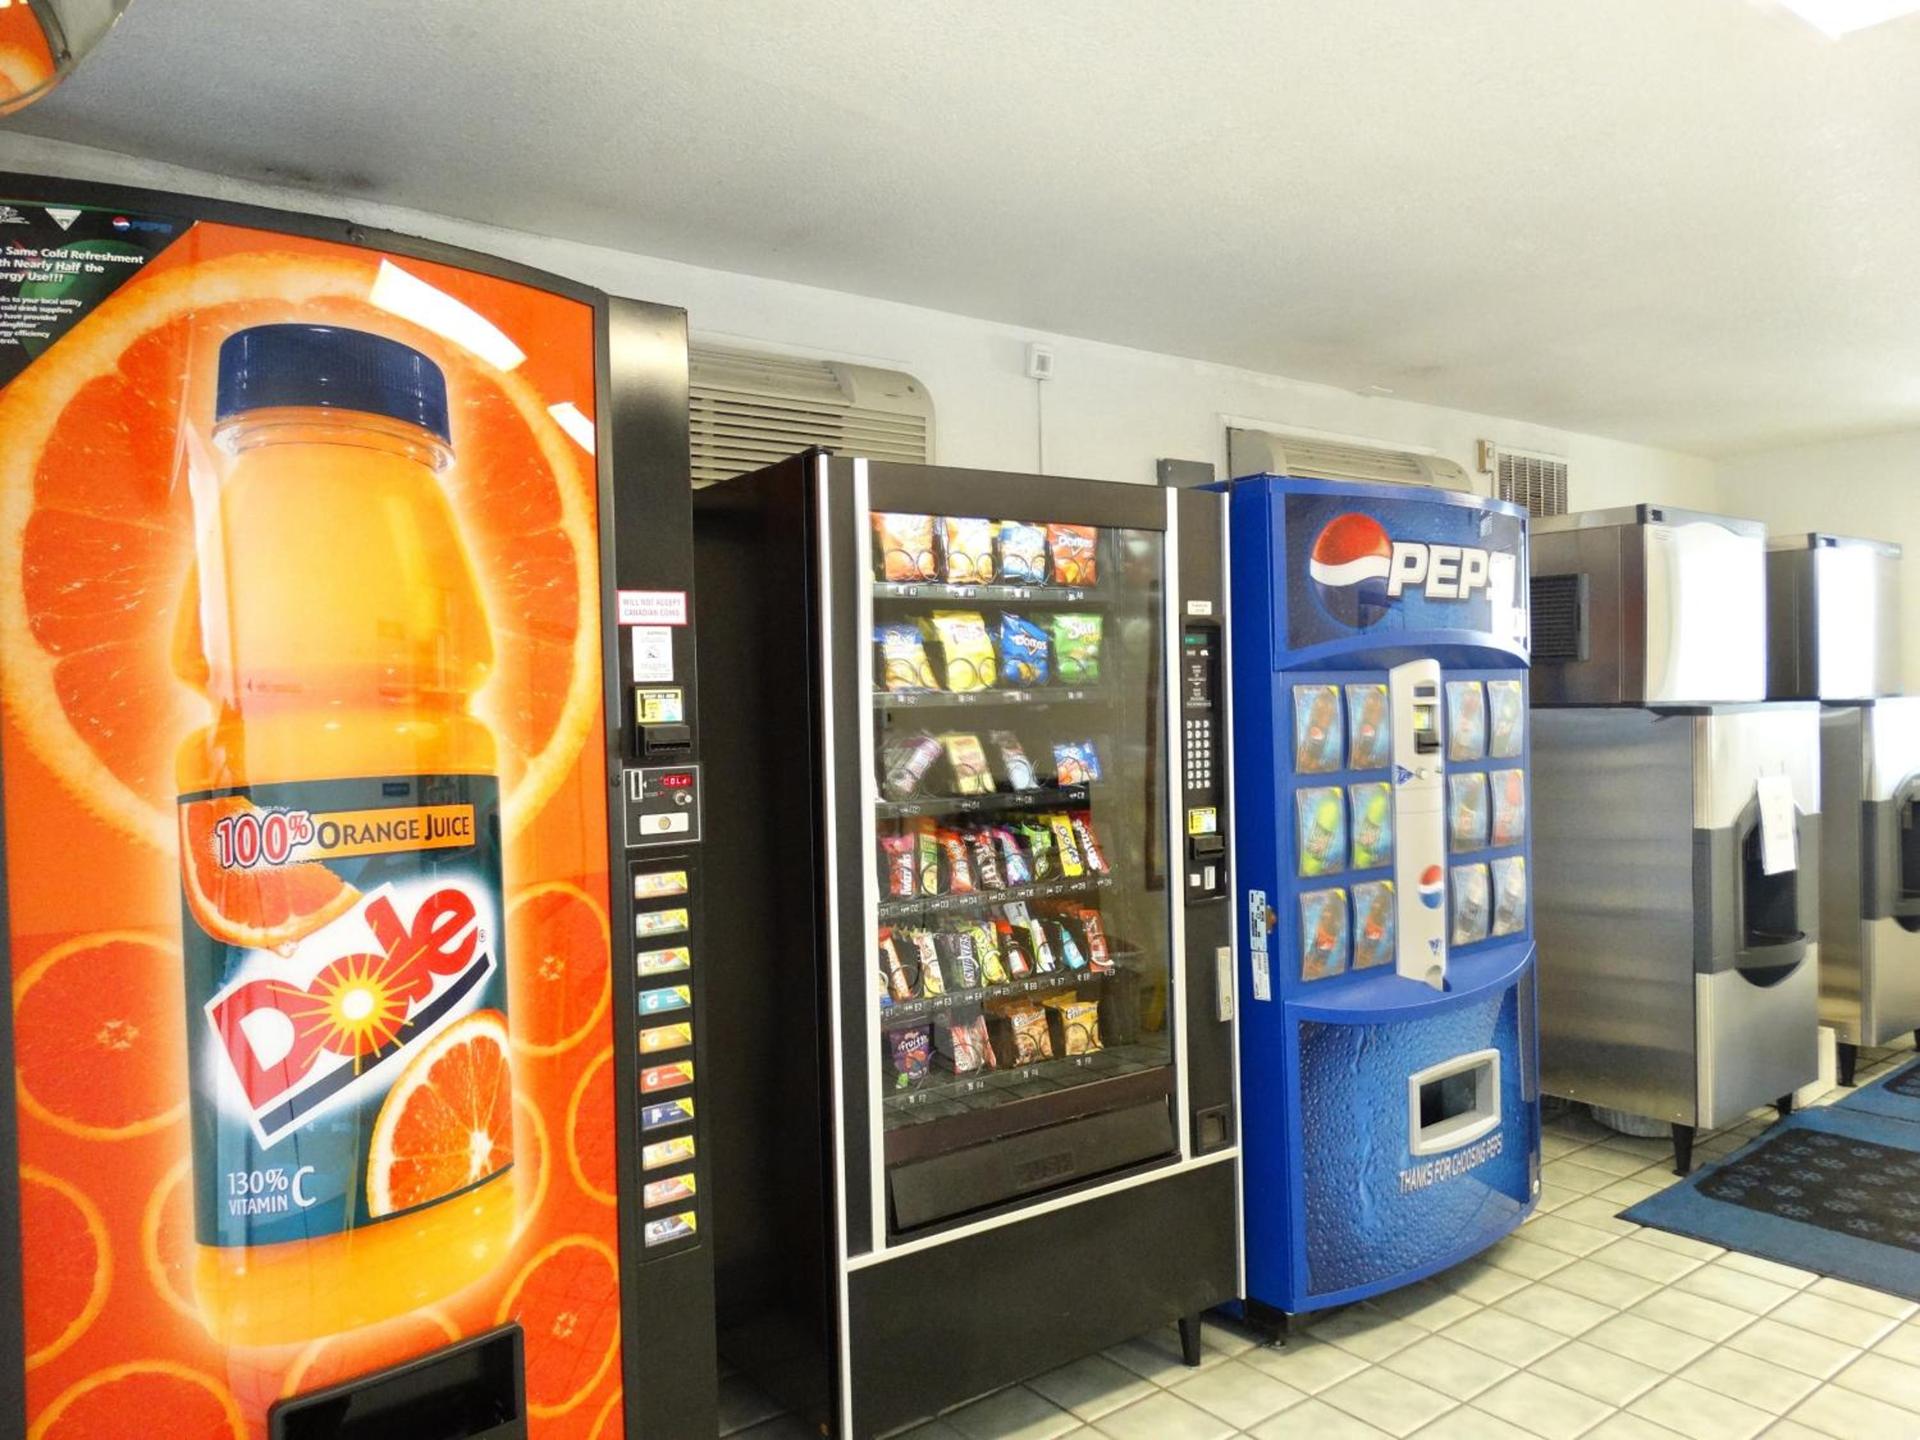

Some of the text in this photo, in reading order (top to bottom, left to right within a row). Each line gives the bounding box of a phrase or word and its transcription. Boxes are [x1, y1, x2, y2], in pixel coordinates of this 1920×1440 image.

[6, 246, 144, 265] Same Cold Refreshment
[13, 259, 53, 272] Nearly
[55, 261, 81, 273] Half
[85, 264, 105, 274] the
[216, 811, 470, 869] 100% ORANGE JUICE
[211, 888, 479, 1111] Dole
[226, 1167, 289, 1196] 130%
[228, 1165, 317, 1217] VITAMIN C
[1400, 1161, 1433, 1194] THANKS
[1433, 1156, 1452, 1182] FOR
